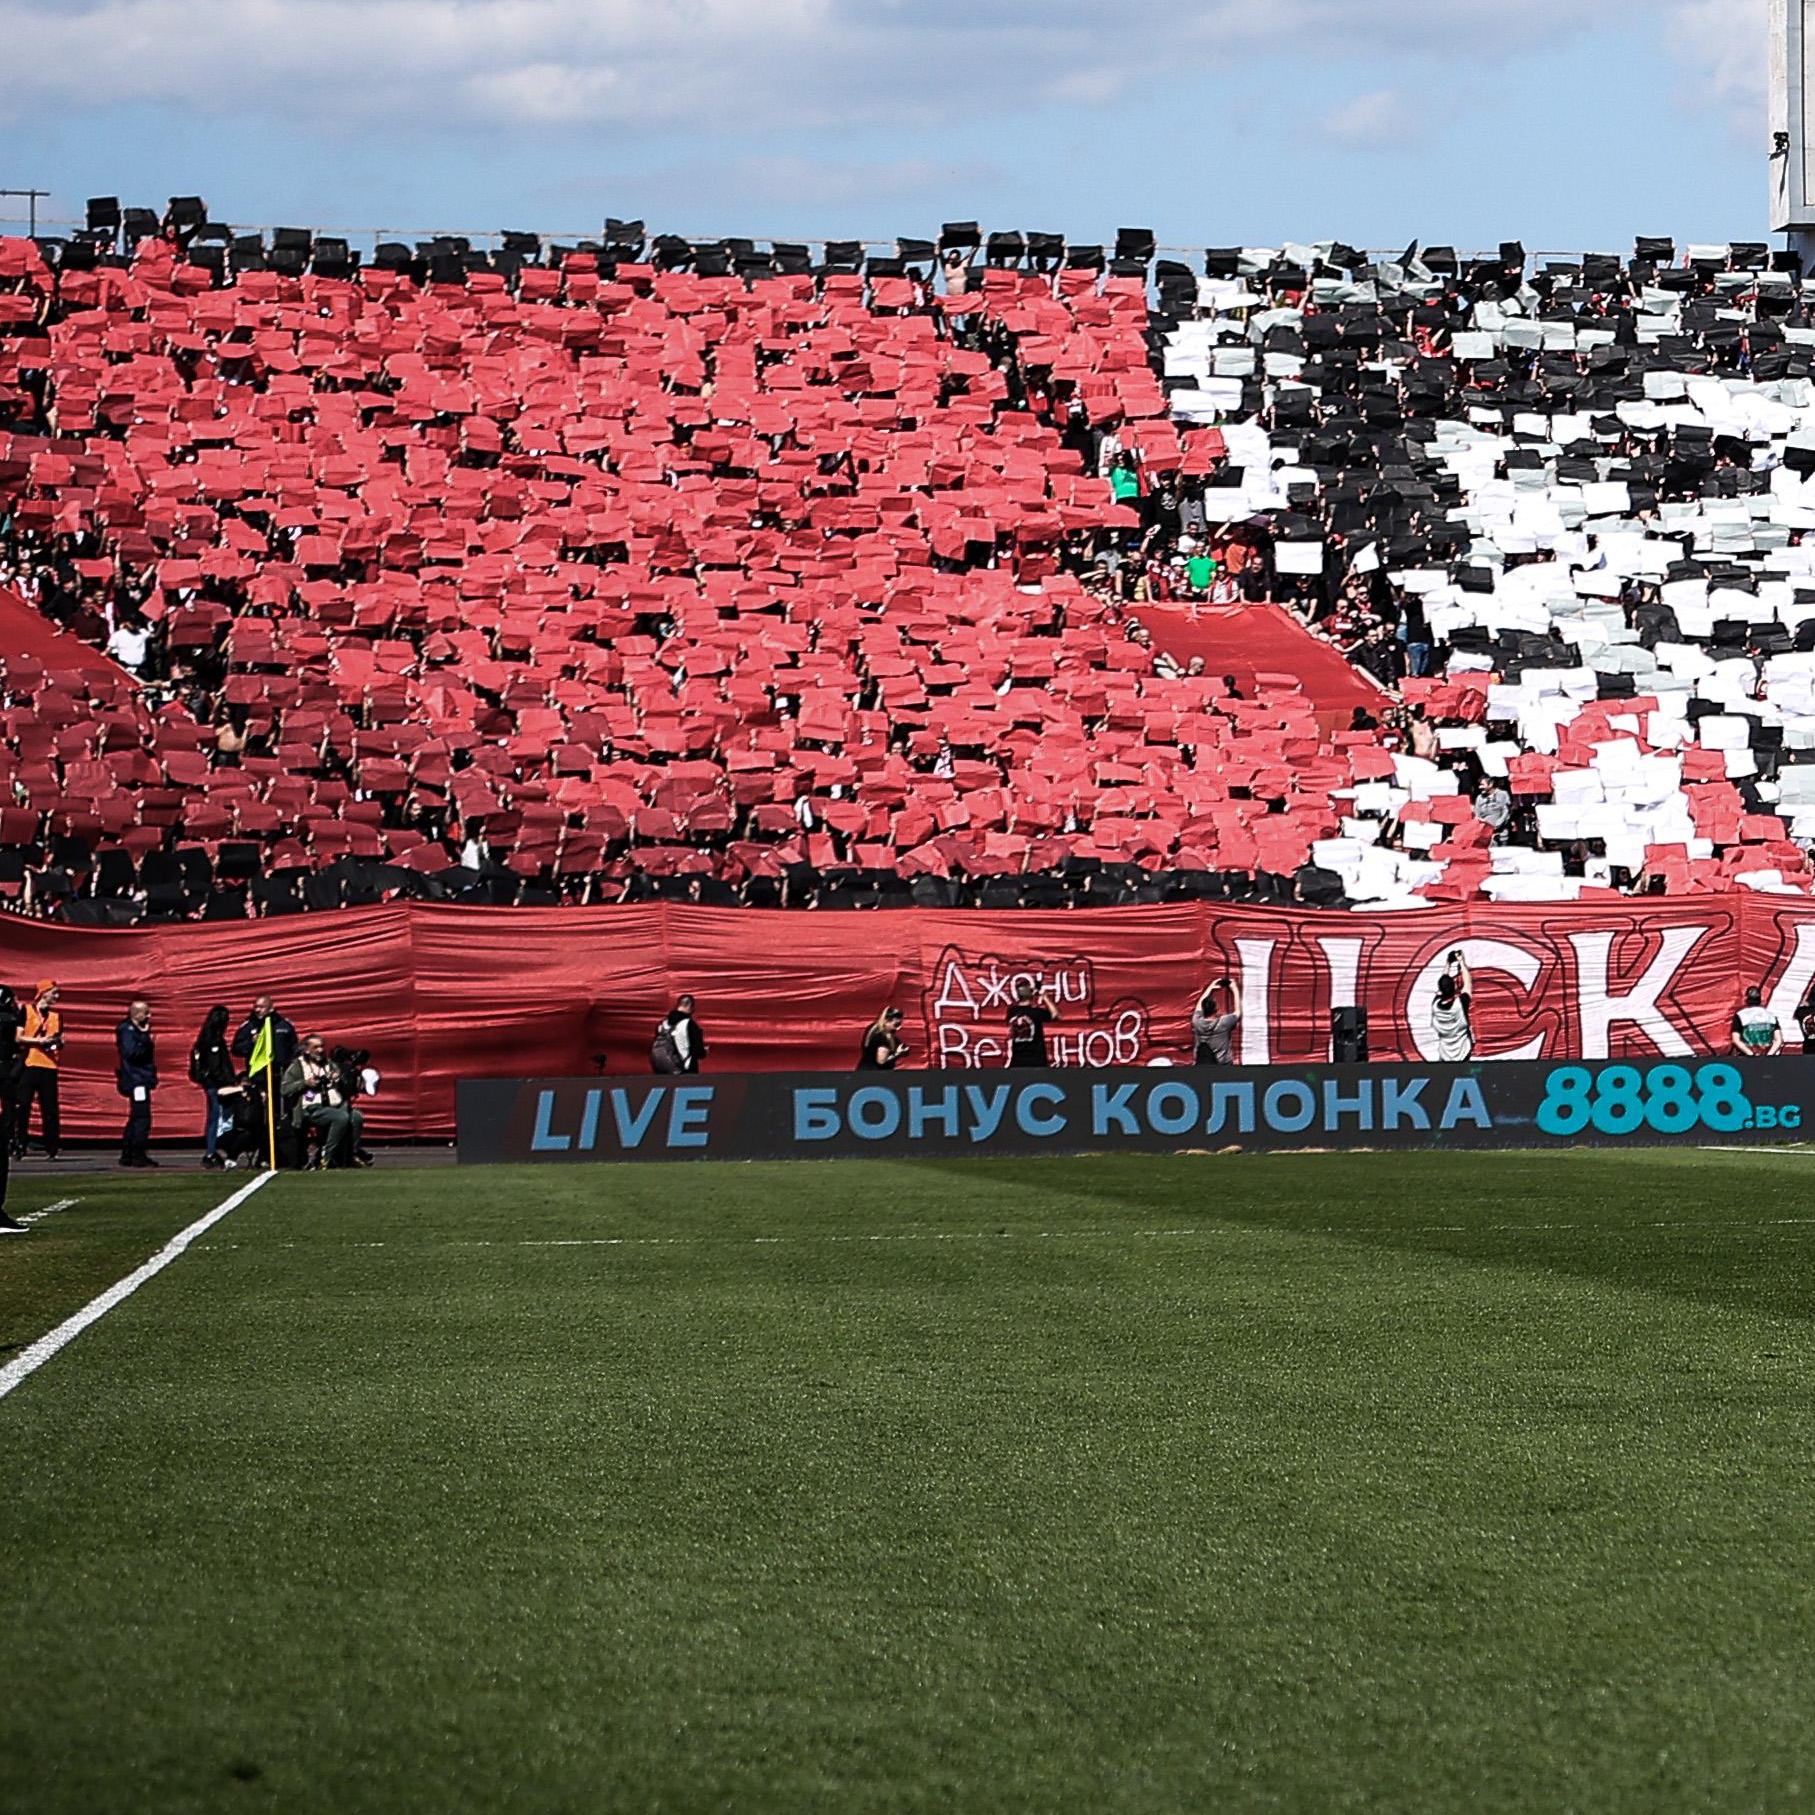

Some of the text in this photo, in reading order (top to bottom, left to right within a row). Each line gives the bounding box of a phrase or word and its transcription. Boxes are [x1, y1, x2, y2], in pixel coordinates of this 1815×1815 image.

[531, 1085, 715, 1151] LIVE
[793, 1062, 1801, 1142] БОНУС КОЛОНКА 8888.BG
